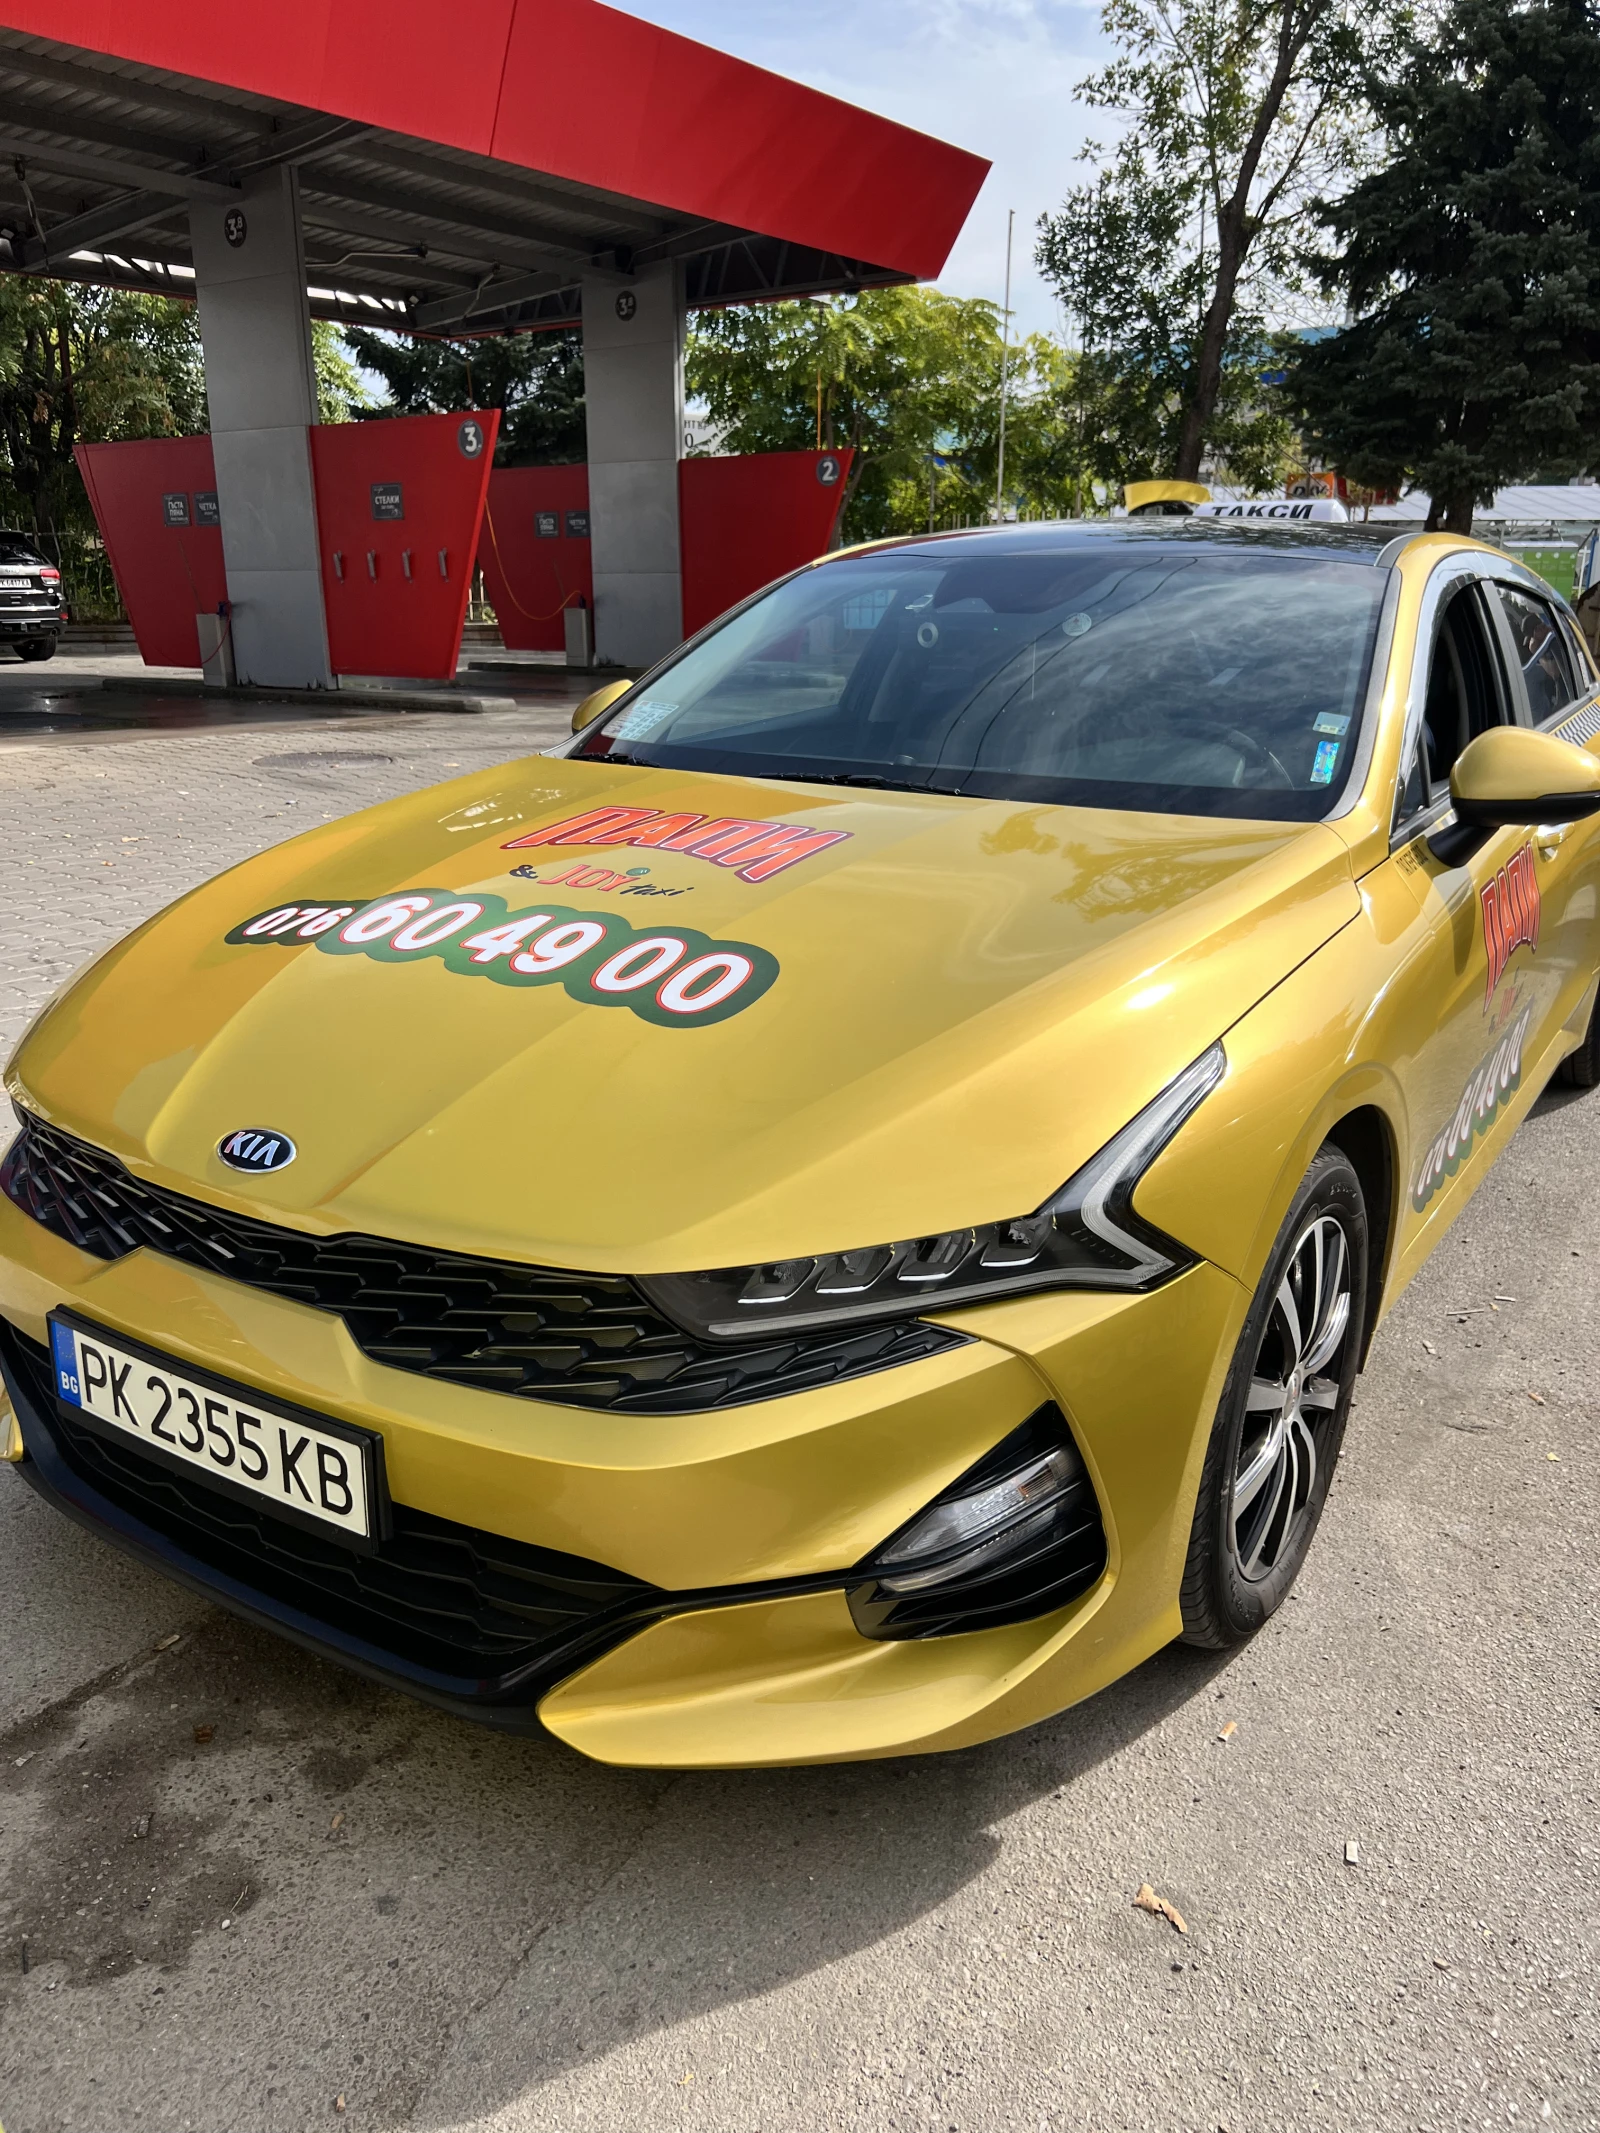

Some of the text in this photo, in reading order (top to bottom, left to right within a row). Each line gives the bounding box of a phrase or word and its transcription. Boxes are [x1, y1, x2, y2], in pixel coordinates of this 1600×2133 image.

[464, 426, 477, 453] 3
[822, 461, 834, 482] 2
[374, 495, 400, 505] СТЕЛКИ
[1211, 504, 1314, 519] ТАКСИ
[501, 806, 854, 884] ПАПИ
[509, 864, 695, 897] & JOY taxi
[1480, 838, 1541, 1016] ПАПИ
[241, 895, 755, 1015] 076 60 49 00
[223, 1131, 281, 1167] KIA
[61, 1342, 353, 1516] BG PK 2355 KB
